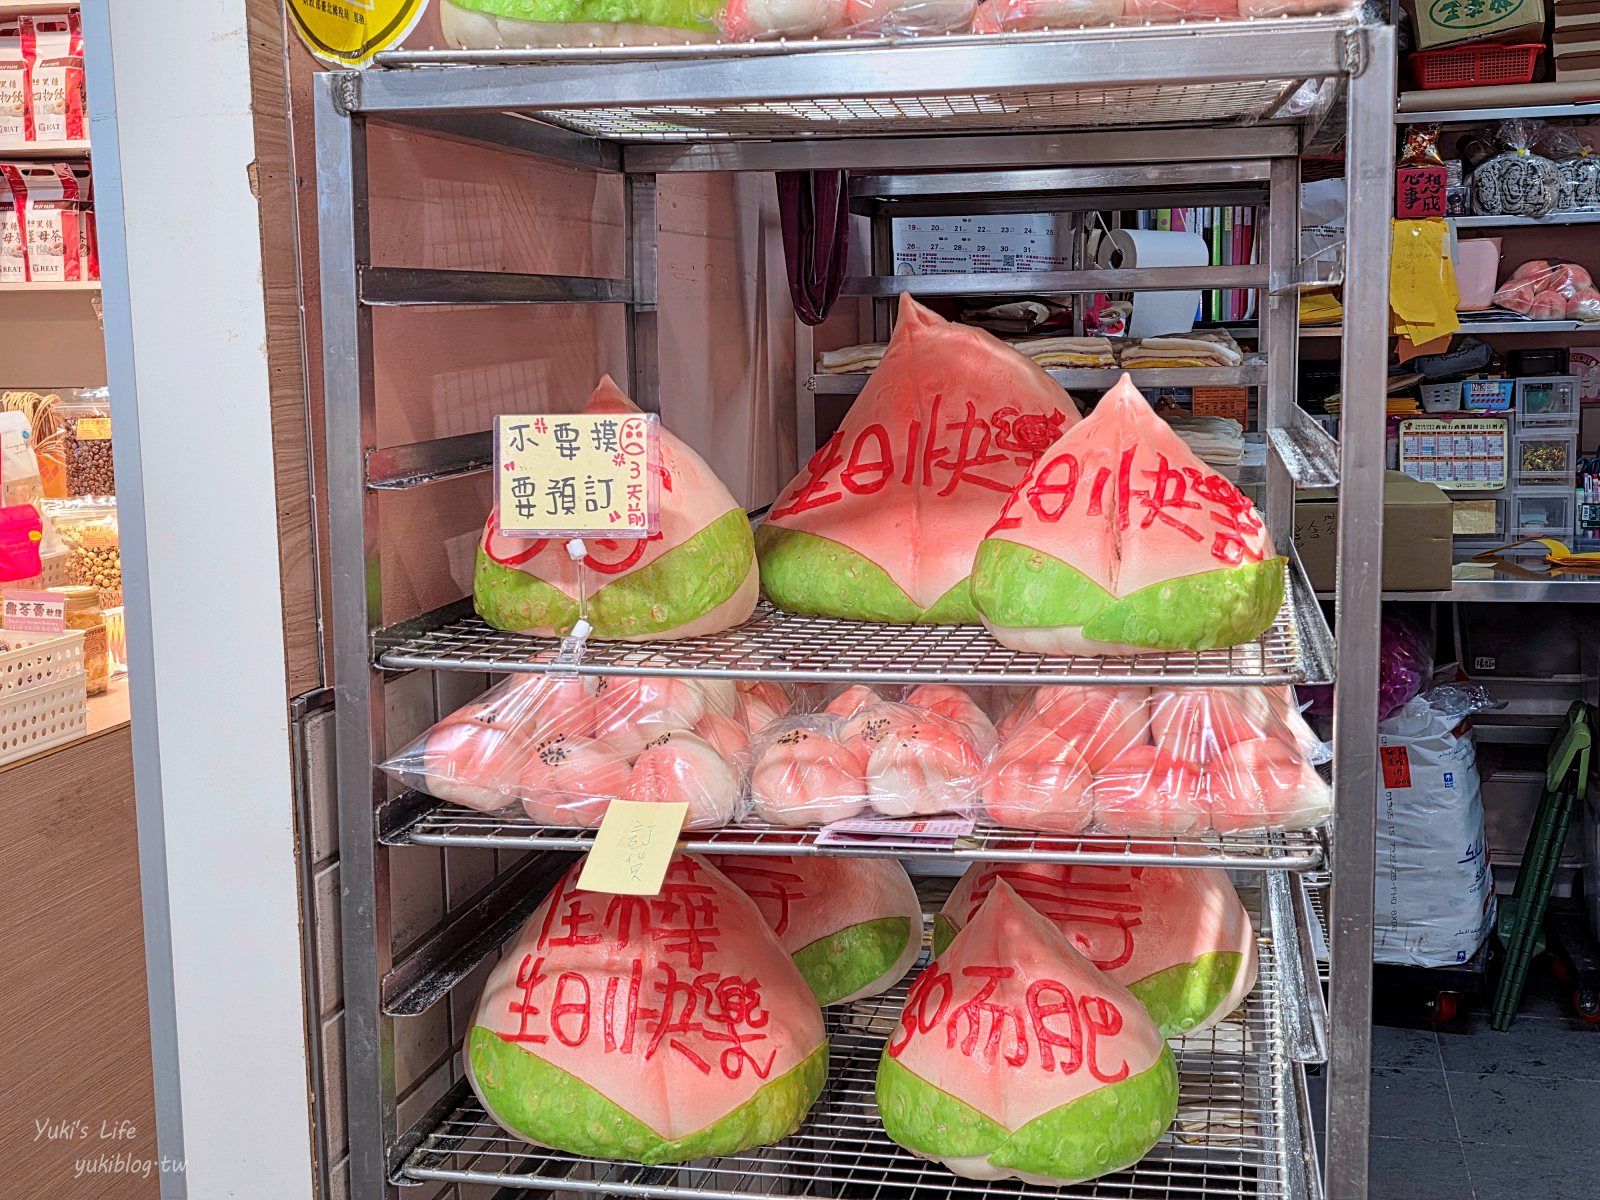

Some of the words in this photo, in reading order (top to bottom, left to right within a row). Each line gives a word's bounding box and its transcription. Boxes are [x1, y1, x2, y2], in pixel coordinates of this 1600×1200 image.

[509, 420, 618, 460] 不要摸
[511, 475, 614, 519] 要預訂
[627, 461, 646, 527] 3天前
[495, 953, 777, 1080] 生日快樂
